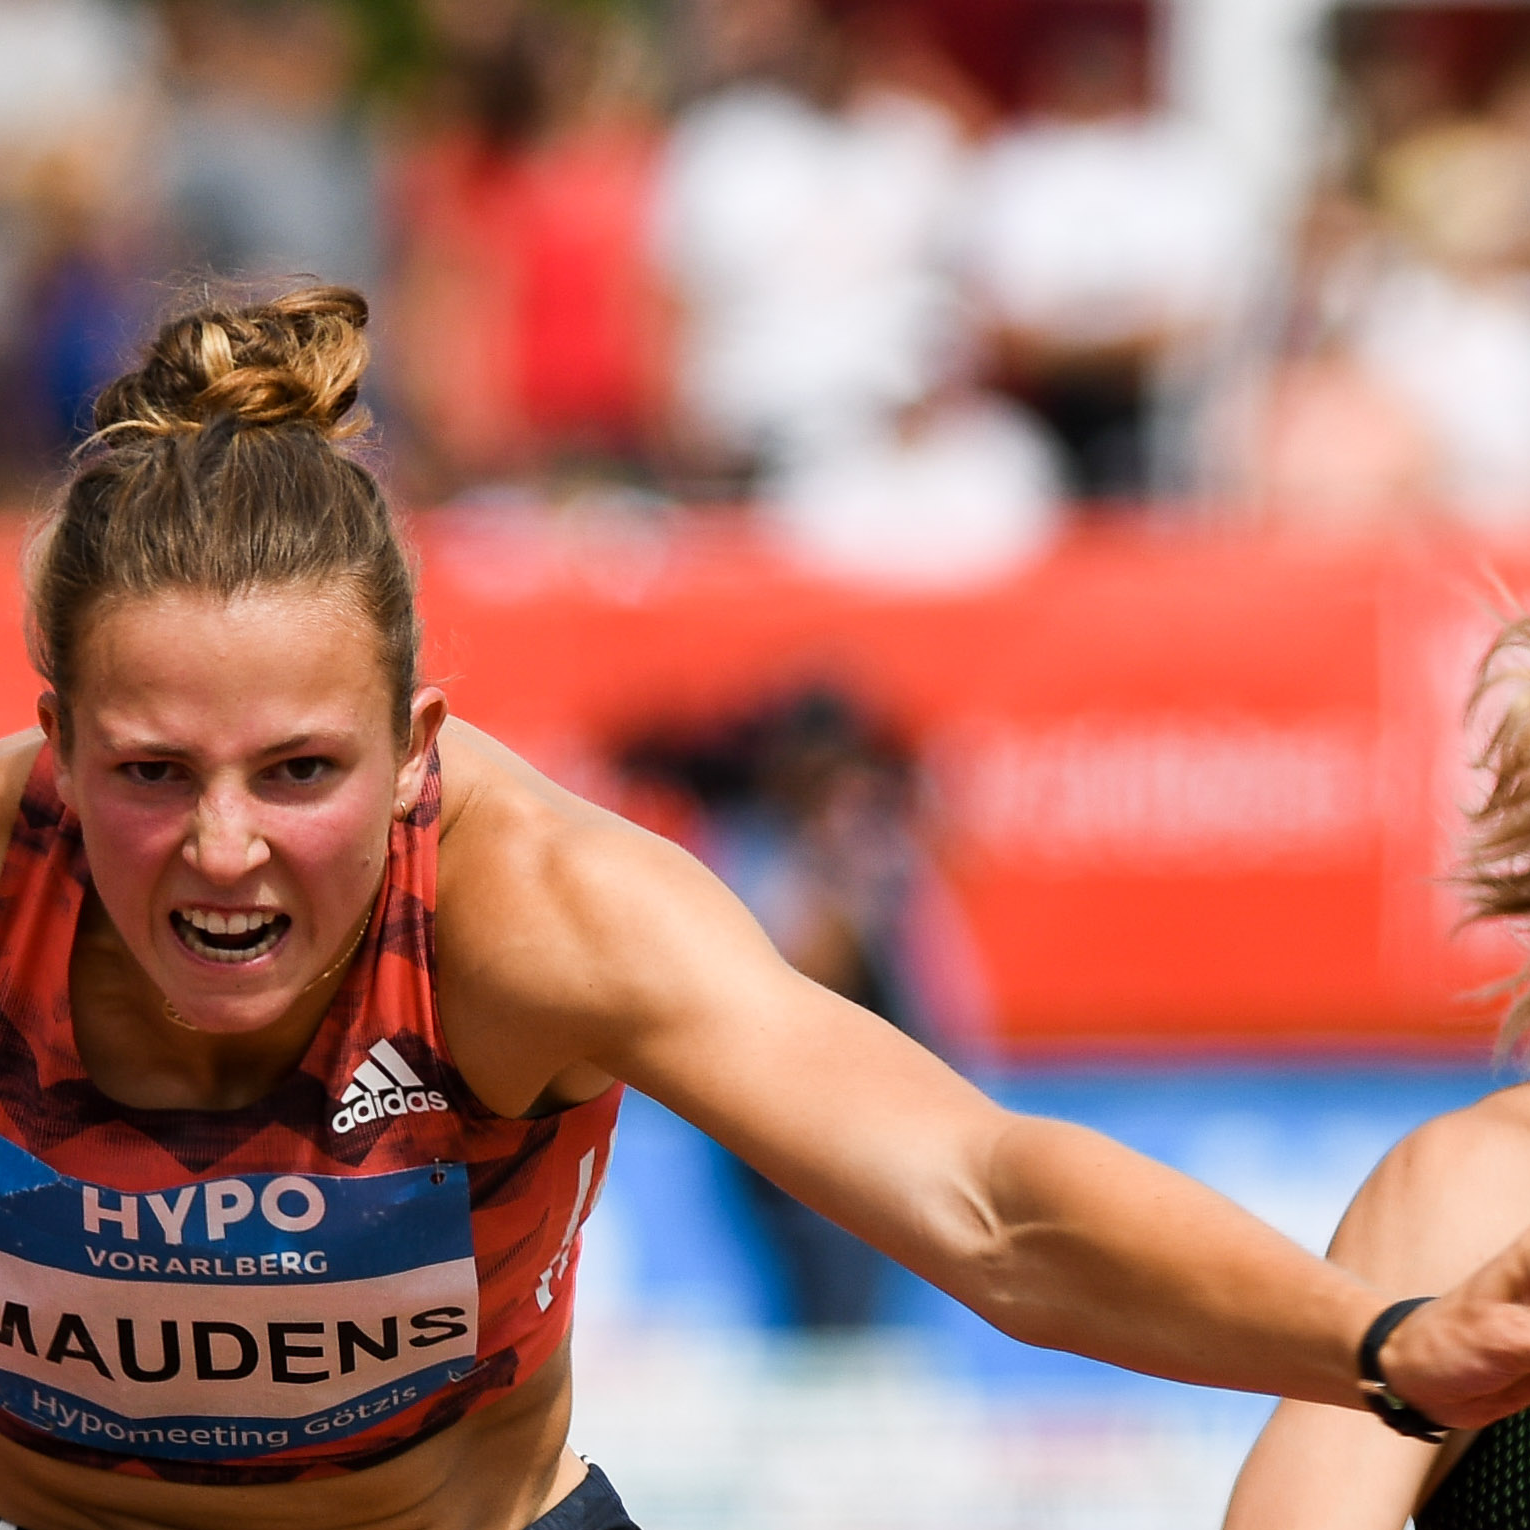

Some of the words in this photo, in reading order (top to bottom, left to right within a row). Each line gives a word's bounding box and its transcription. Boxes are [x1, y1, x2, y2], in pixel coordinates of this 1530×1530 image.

[332, 1085, 448, 1135] adidas
[82, 1177, 326, 1245] HYPO
[85, 1245, 328, 1277] VORARLBERG
[33, 1389, 289, 1448] Hypomeeting
[304, 1384, 417, 1436] Götzis
